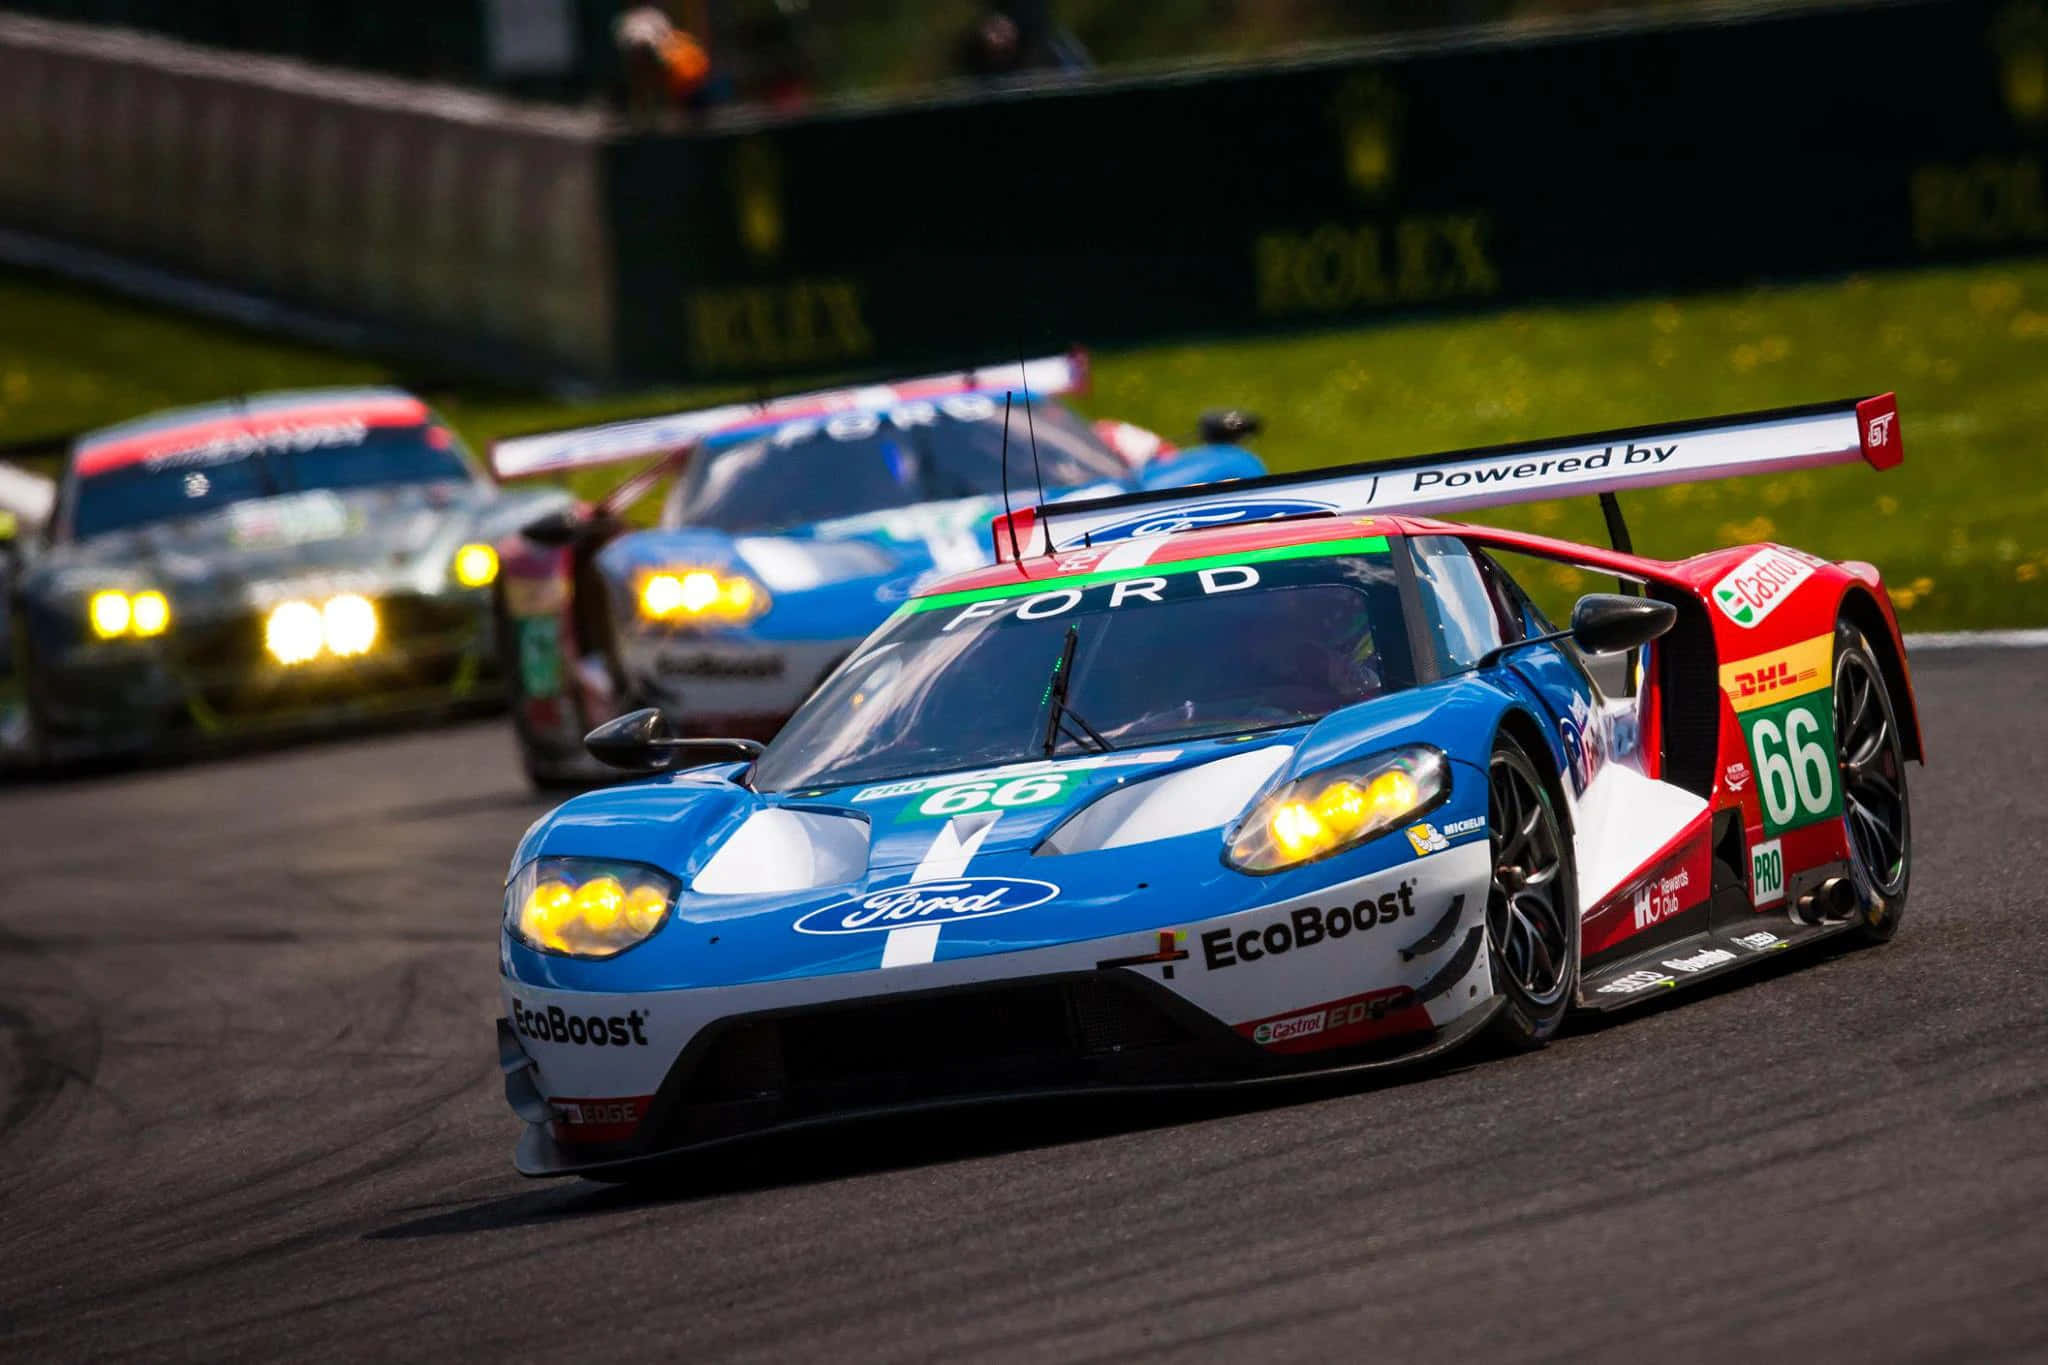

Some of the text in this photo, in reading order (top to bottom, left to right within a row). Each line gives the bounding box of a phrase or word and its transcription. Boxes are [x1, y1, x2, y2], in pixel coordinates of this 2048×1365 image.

[1909, 160, 2048, 244] ROL
[1256, 214, 1498, 312] ROLEX
[1868, 411, 1896, 448] GT
[1412, 443, 1679, 492] Powered by
[942, 565, 1260, 632] FORD
[1734, 553, 1803, 609] Castrol
[1734, 661, 1798, 697] DHL
[1752, 707, 1833, 826] 66
[857, 781, 928, 800] PRO
[919, 774, 1069, 816] 66
[1444, 816, 1486, 835] MICHELIN
[1661, 867, 1689, 896] Rewards
[1754, 852, 1782, 896] PRO
[841, 884, 1007, 929] Ford
[1662, 892, 1679, 916] Club
[1271, 1014, 1321, 1039] Castrol
[583, 1102, 640, 1125] EDGE
